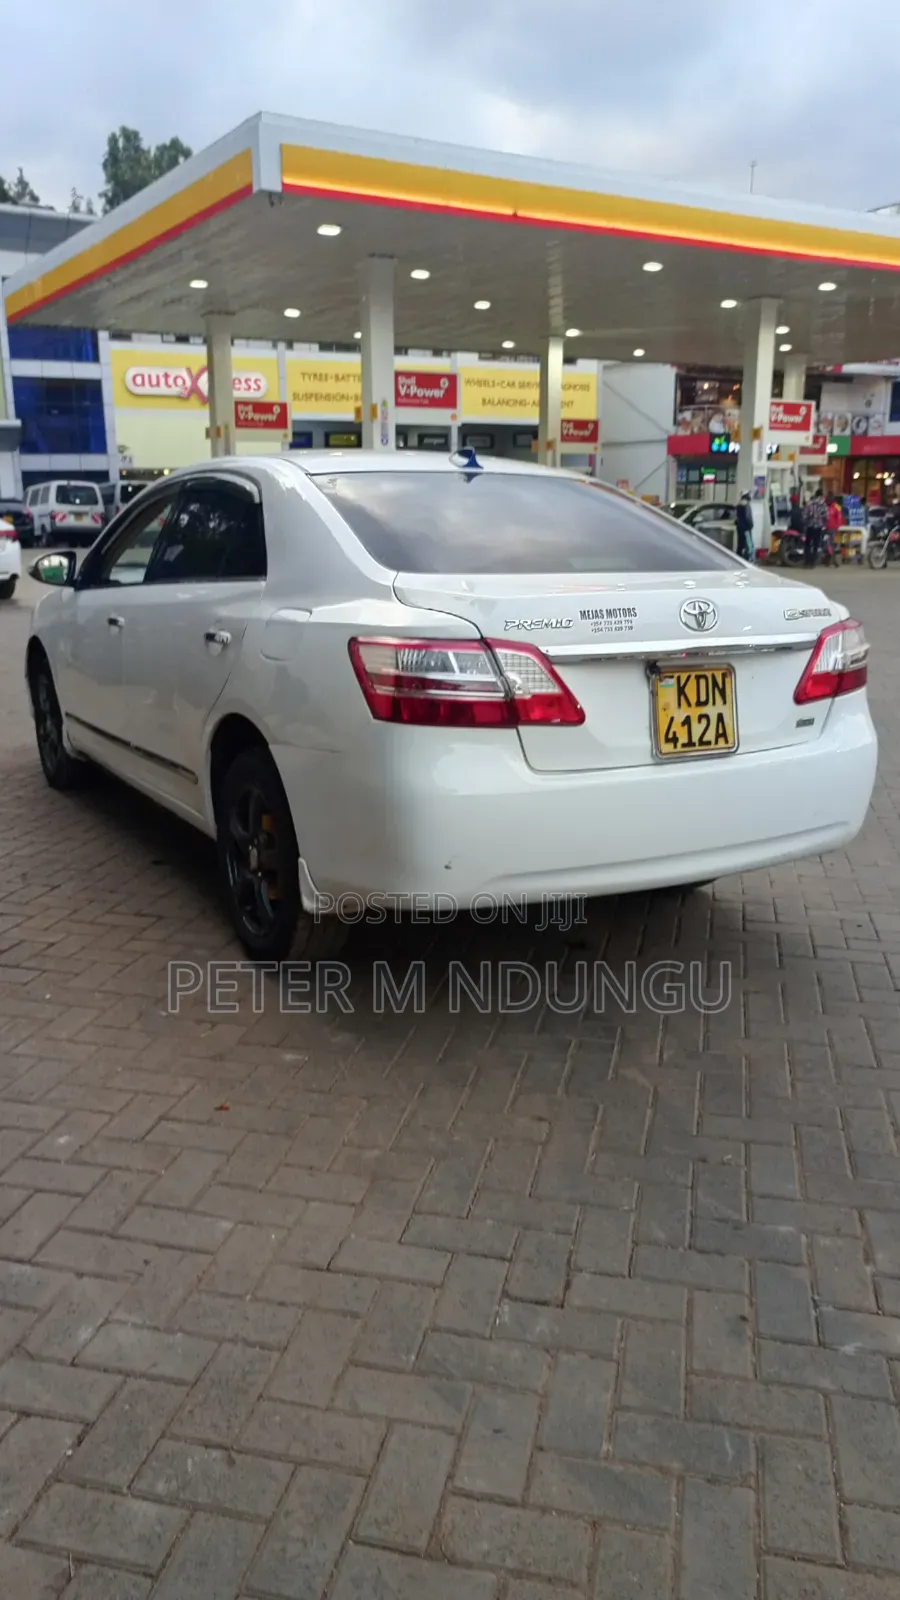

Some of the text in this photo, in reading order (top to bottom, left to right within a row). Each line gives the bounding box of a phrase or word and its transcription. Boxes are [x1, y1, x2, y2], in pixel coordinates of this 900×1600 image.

[131, 366, 262, 404] autoXess
[399, 384, 446, 398] V-Power
[504, 617, 575, 631] PREMIO
[579, 606, 638, 621] MEJAS MOTORS
[676, 671, 728, 709] KDN
[663, 712, 730, 749] 412A
